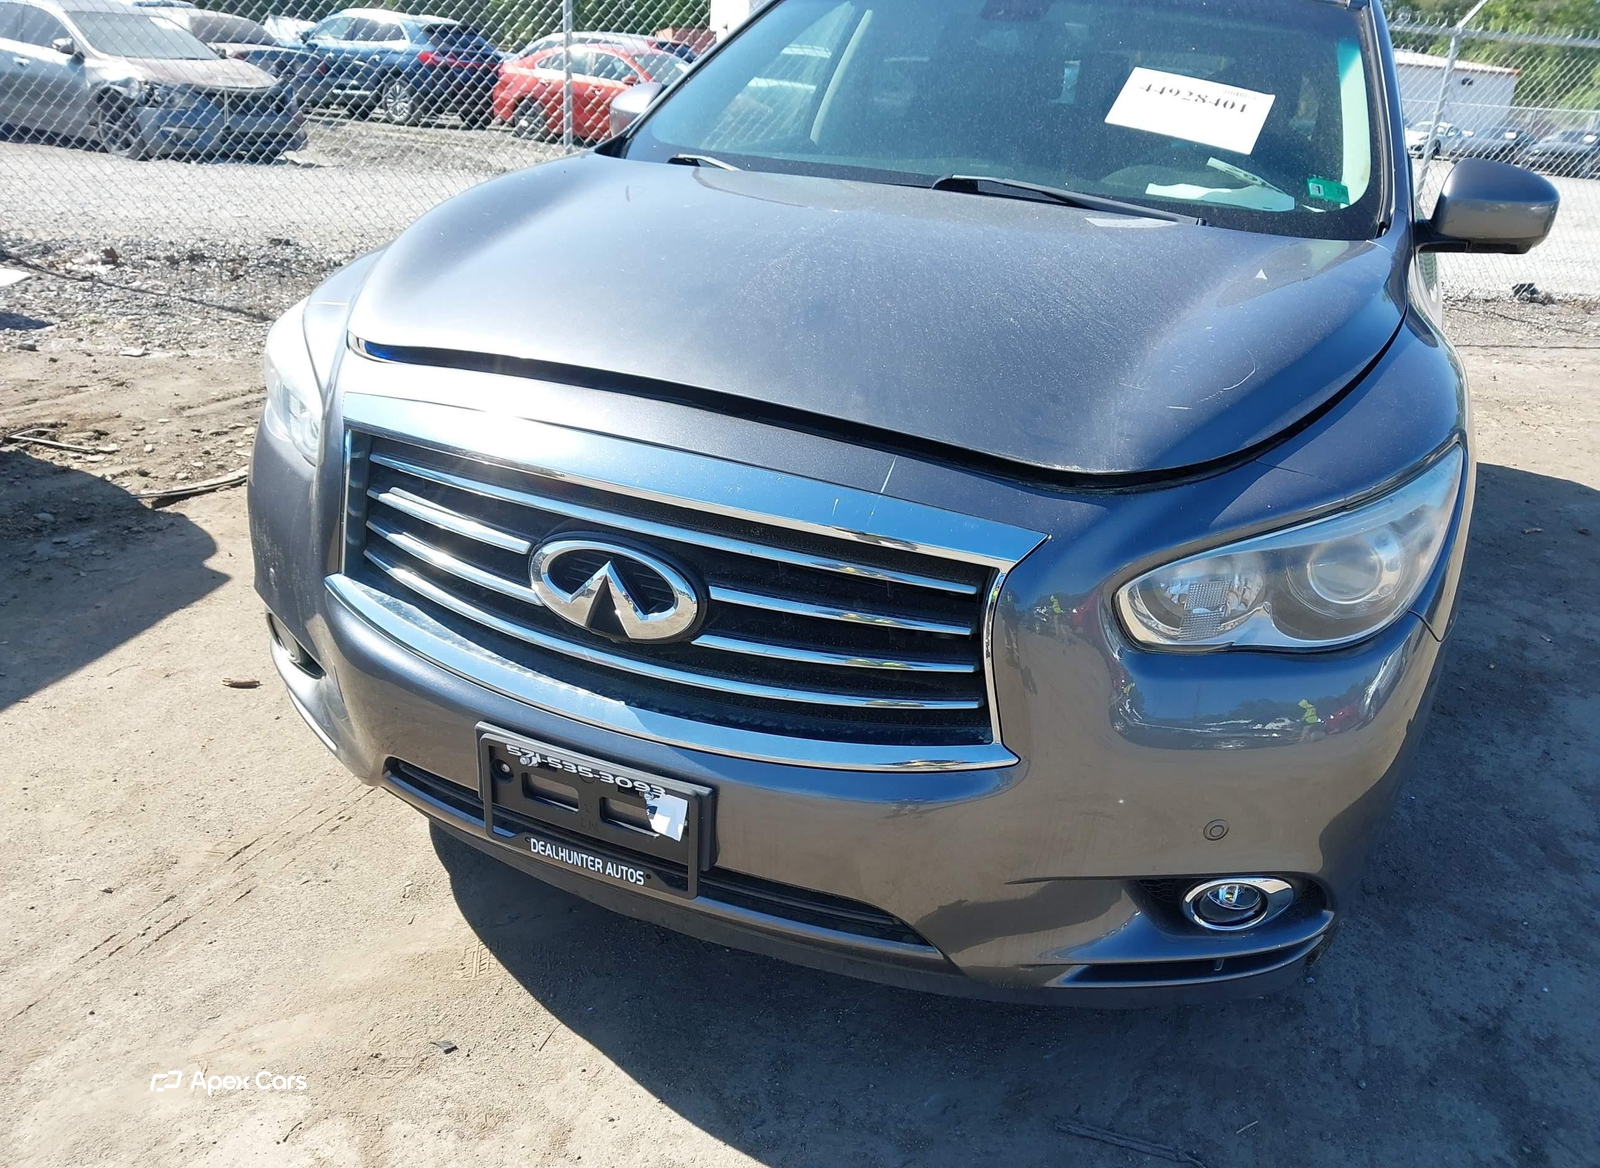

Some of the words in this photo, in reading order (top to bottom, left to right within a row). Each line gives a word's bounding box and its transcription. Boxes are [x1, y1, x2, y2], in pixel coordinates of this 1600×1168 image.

[1140, 83, 1247, 113] 44928401
[505, 744, 666, 798] 571-535-3093
[530, 837, 603, 874] DEALHUNTER
[605, 861, 645, 886] AUTOS
